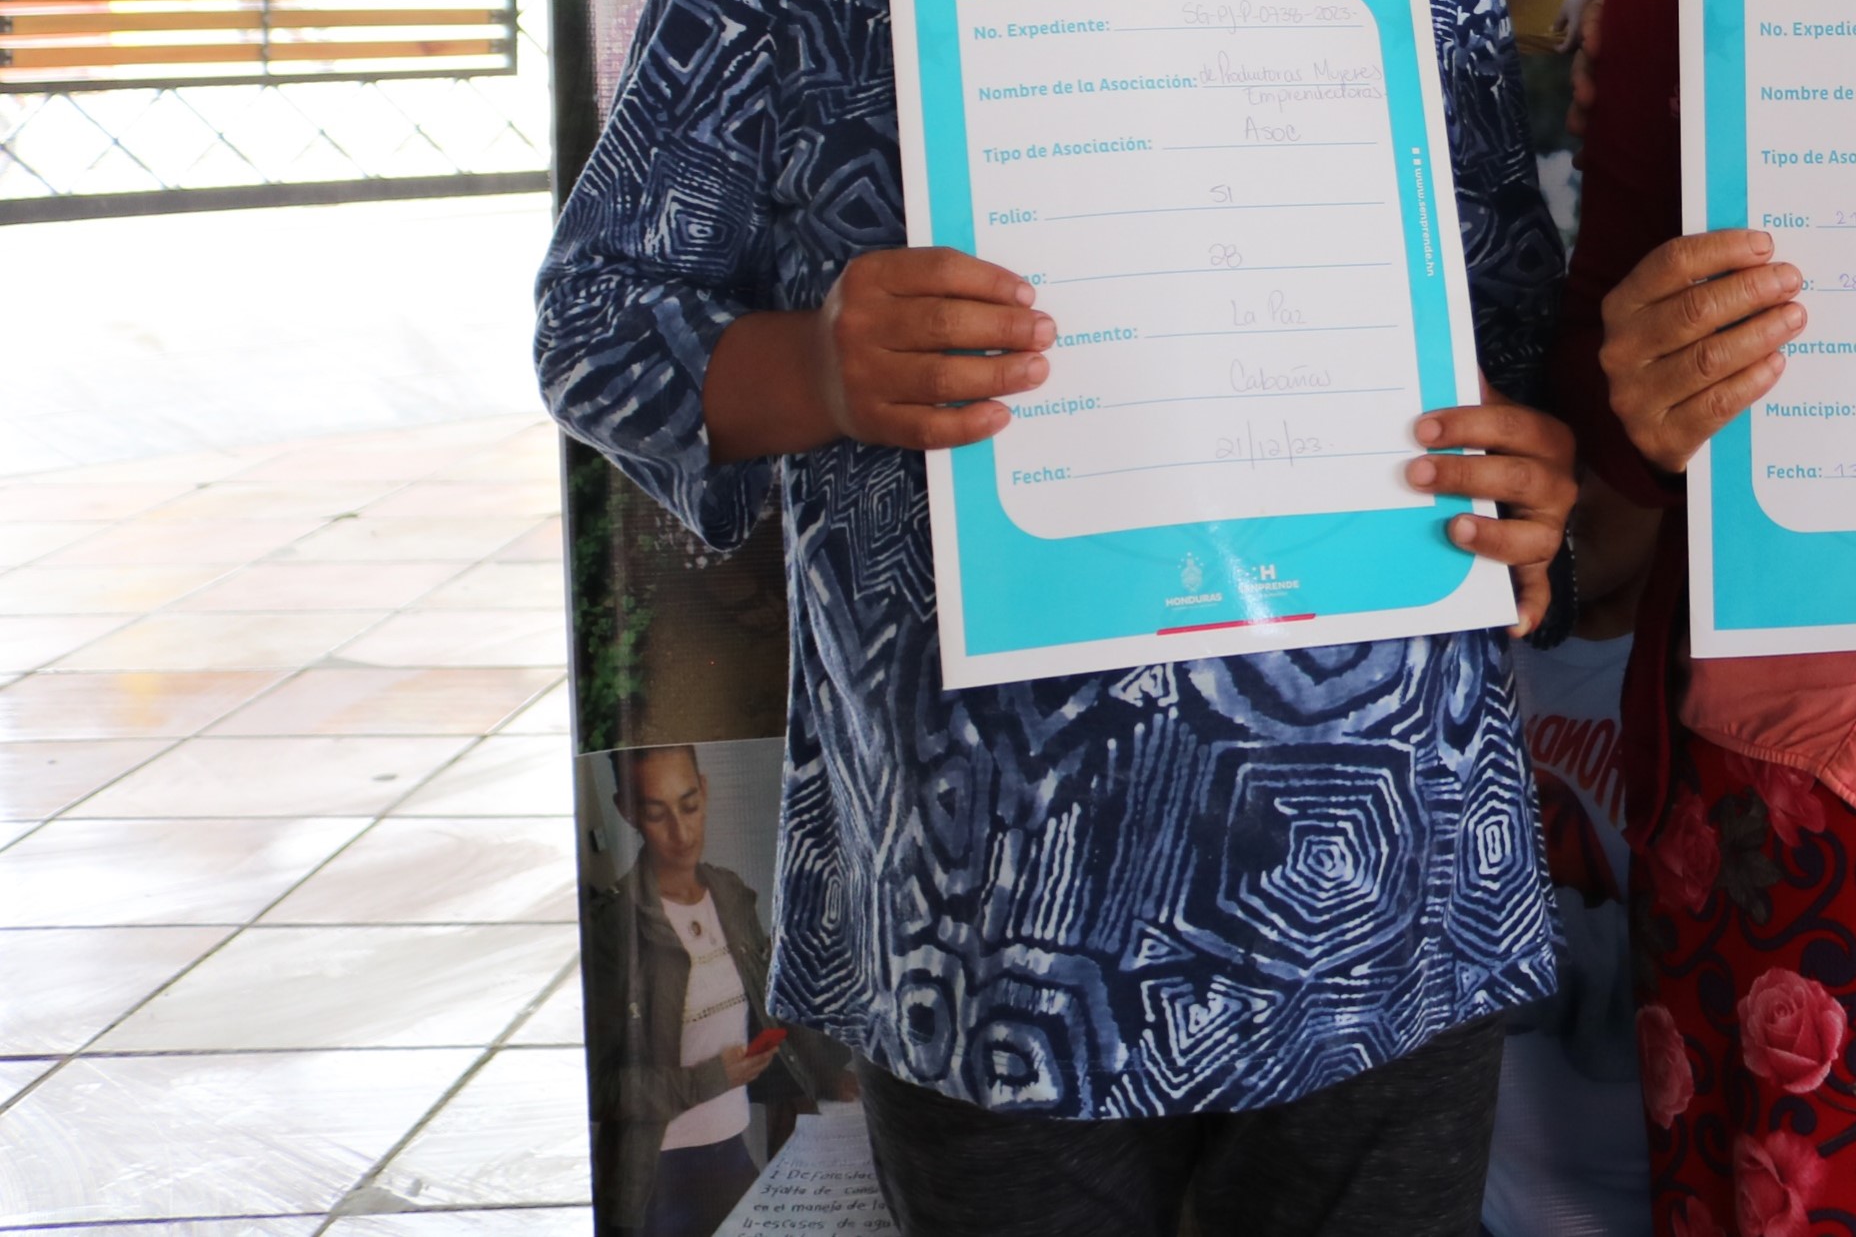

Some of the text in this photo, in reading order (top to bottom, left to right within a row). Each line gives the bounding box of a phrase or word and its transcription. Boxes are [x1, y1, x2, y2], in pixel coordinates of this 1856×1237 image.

[974, 19, 1110, 40] No. Expediente:
[1760, 22, 1787, 36] No.
[978, 74, 1198, 101] Nombre de la Asociación:
[1761, 86, 1829, 100] Nombre
[1833, 85, 1854, 100] de
[983, 136, 1153, 165] Tipo de Asociación:
[1761, 150, 1799, 168] Tipo
[1803, 150, 1824, 164] de
[989, 208, 1037, 226] Folio:
[1762, 212, 1810, 228] Folio:
[1230, 289, 1307, 326] La Paz
[1056, 326, 1138, 347] tamento:
[1007, 396, 1101, 420] Municipio:
[1765, 402, 1856, 419] Municipio:
[1012, 466, 1071, 486] Fecha:
[1767, 464, 1822, 479] Fecha:
[1165, 593, 1223, 607] HONDURAS
